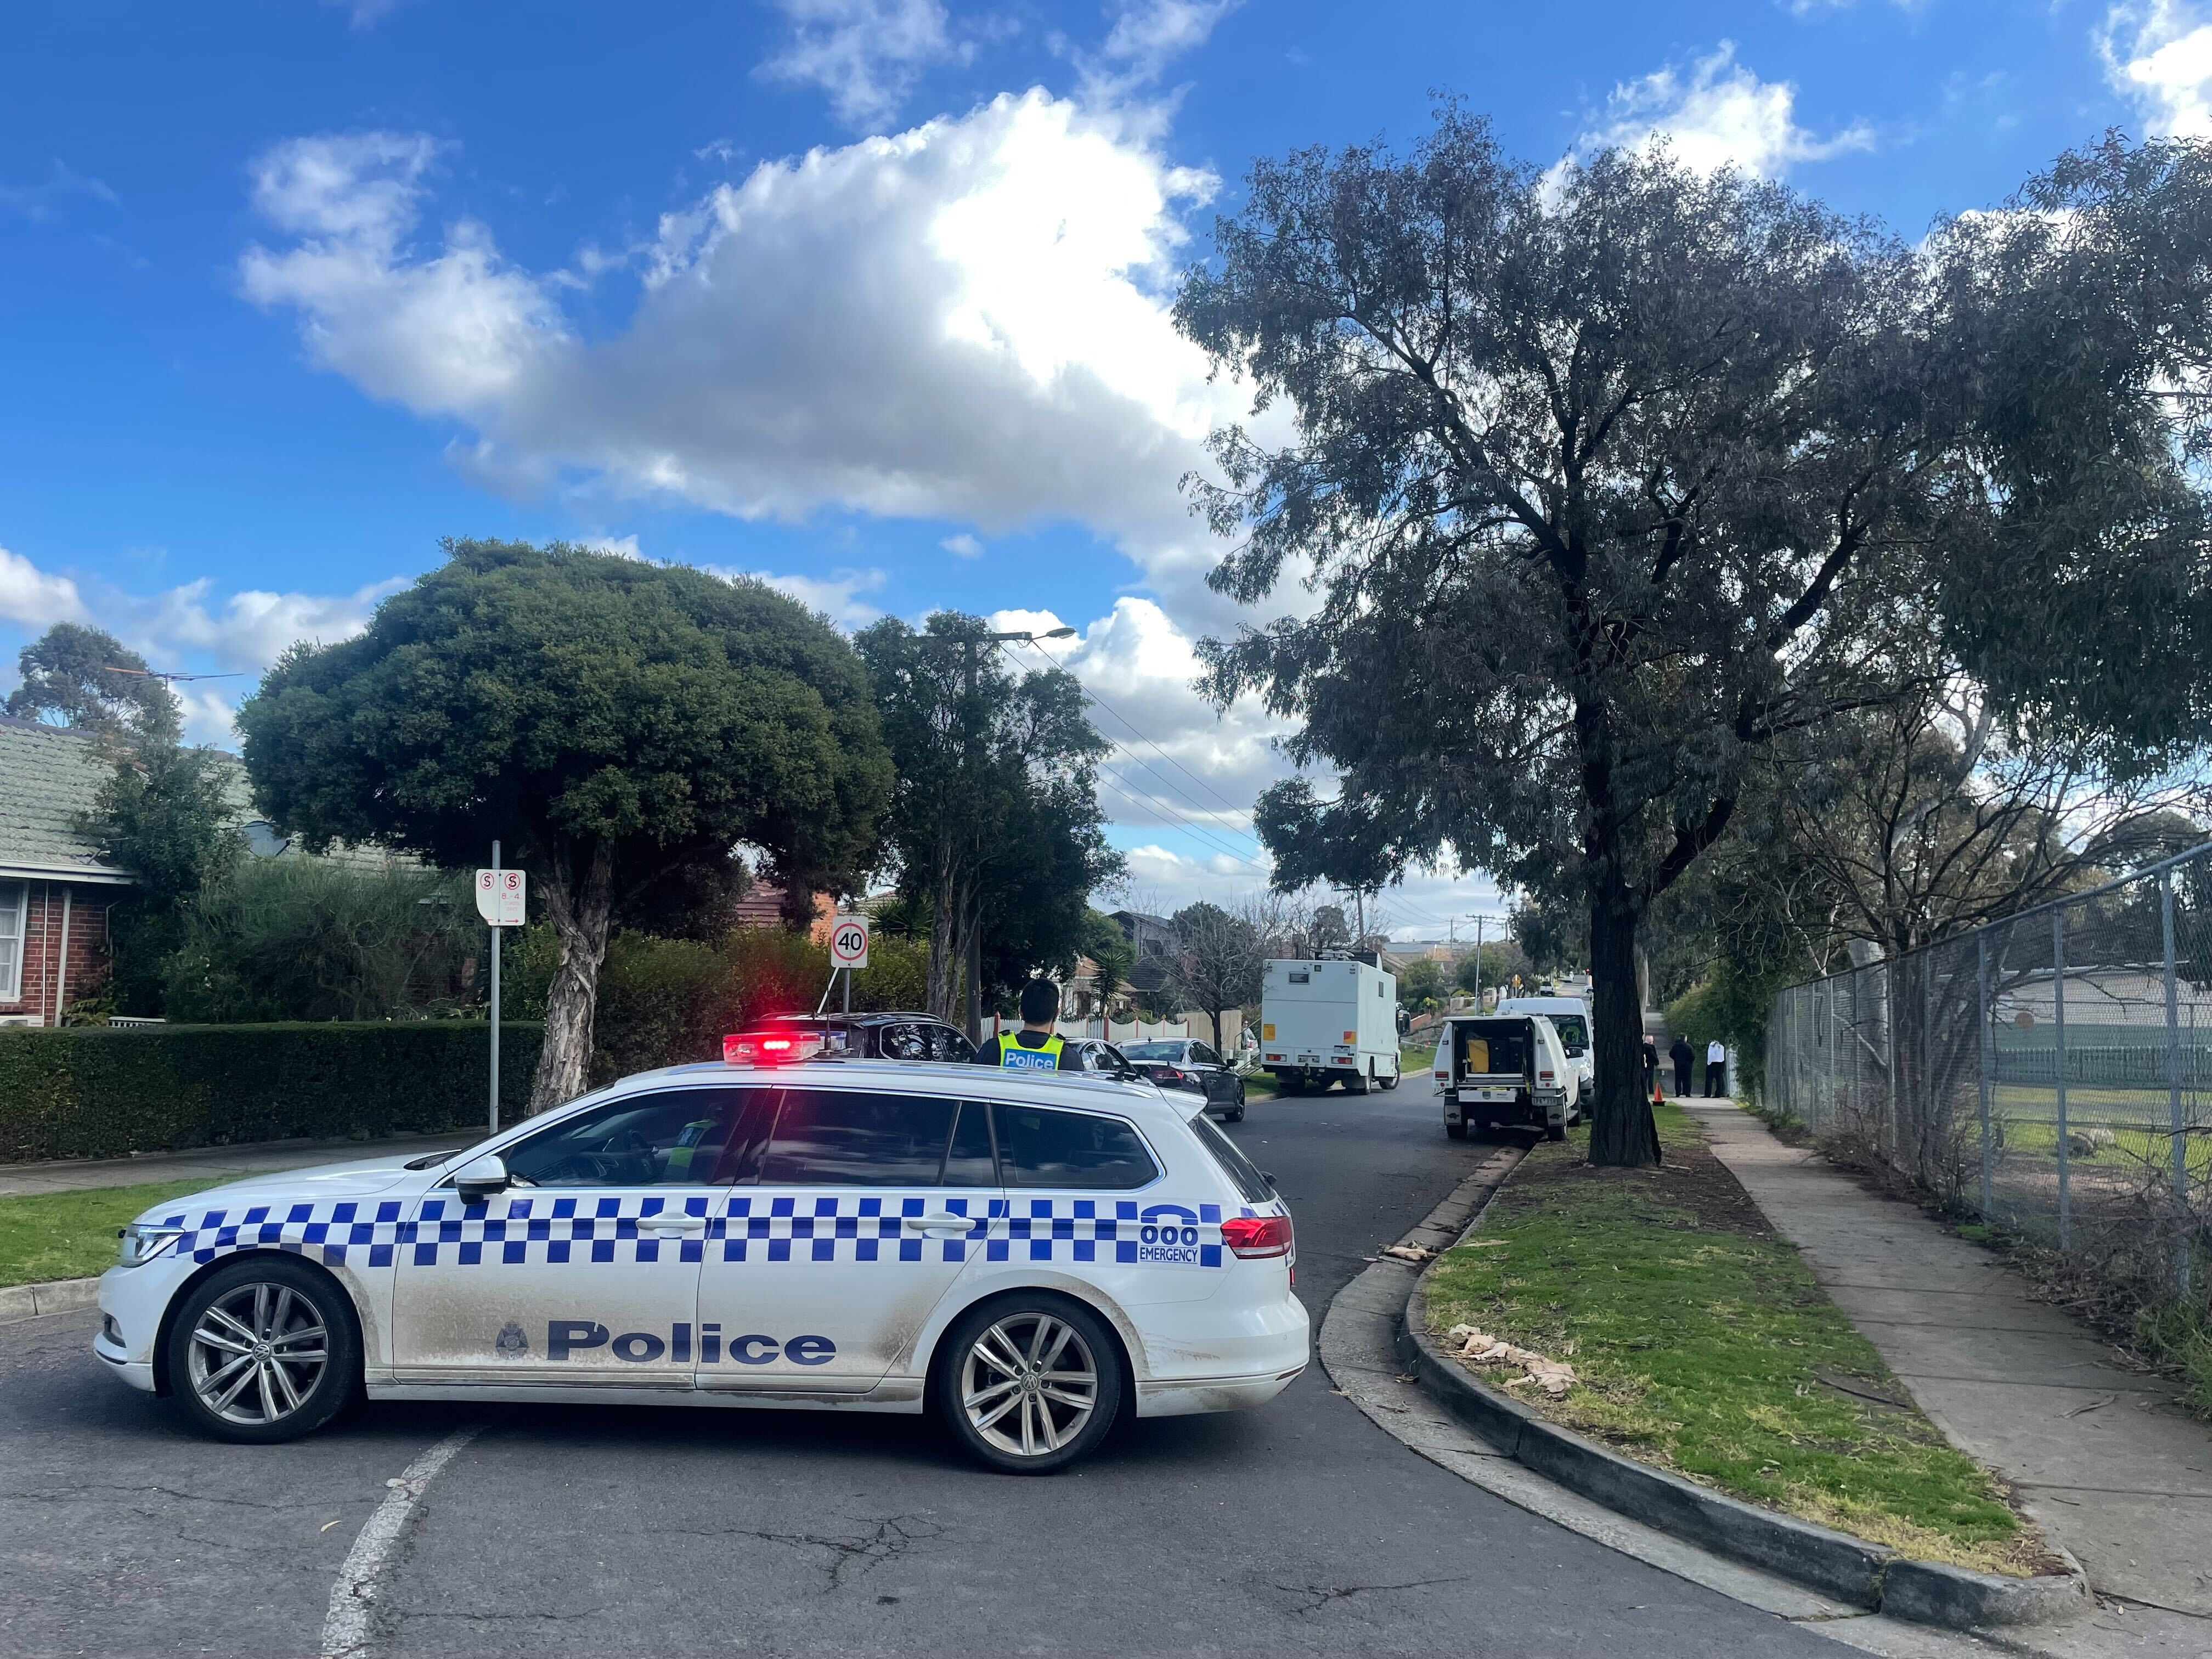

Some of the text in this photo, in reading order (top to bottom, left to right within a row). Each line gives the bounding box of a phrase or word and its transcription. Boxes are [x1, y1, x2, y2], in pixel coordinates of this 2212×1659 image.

[838, 933, 862, 951] 40
[1006, 1052, 1054, 1069] Police
[1141, 1225, 1198, 1246] 000
[1140, 1247, 1198, 1262] EMERGENCY
[549, 1321, 837, 1365] Police
